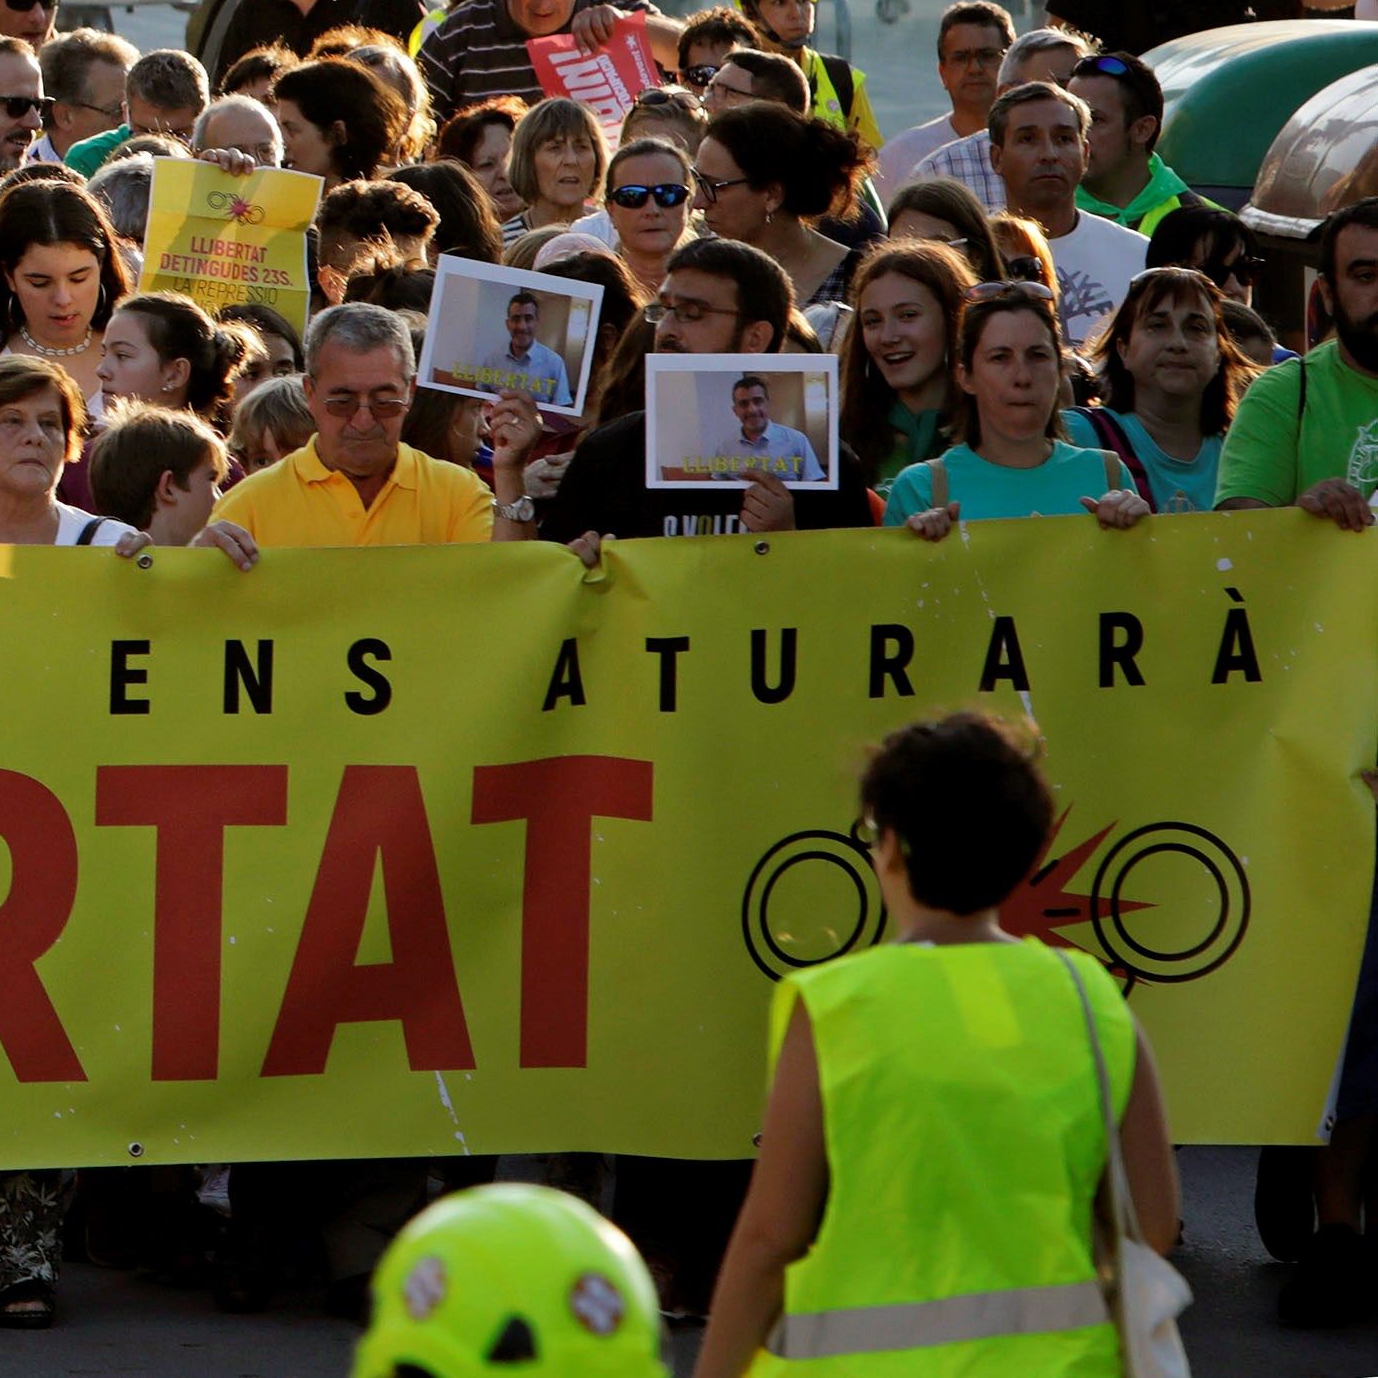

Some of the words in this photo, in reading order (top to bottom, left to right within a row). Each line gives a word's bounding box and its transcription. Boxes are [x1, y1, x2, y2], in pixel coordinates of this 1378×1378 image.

[191, 236, 269, 264] LLIBERTAT
[160, 253, 259, 283] DETINGUDES
[451, 360, 557, 398] LLIBERTAT
[682, 455, 803, 475] LLIBERTAT
[110, 637, 393, 715] ENS
[542, 588, 1265, 714] ATURARÀ
